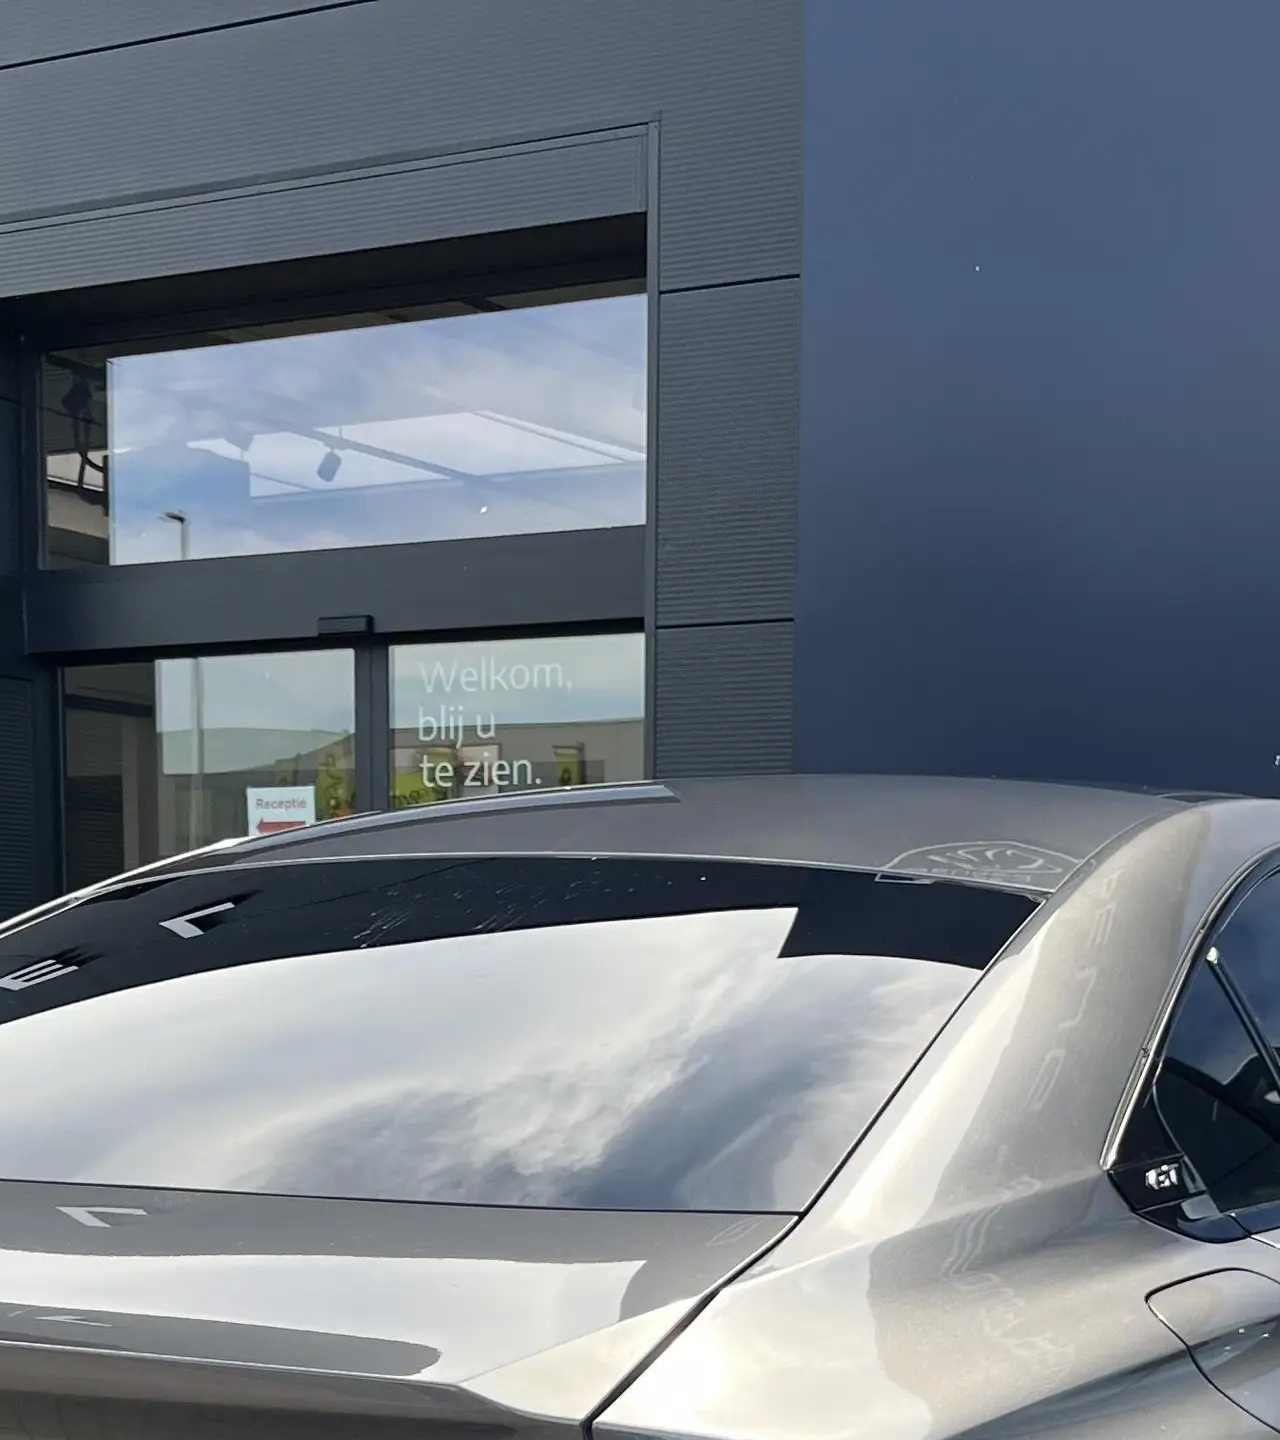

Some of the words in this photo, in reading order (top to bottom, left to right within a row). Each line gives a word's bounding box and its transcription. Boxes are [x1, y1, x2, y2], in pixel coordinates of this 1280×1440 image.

[420, 653, 573, 695] Welkom,
[418, 704, 464, 749] blij
[475, 713, 496, 739] u
[418, 754, 455, 788] te
[463, 751, 542, 787] zien.
[255, 797, 308, 812] Receptie
